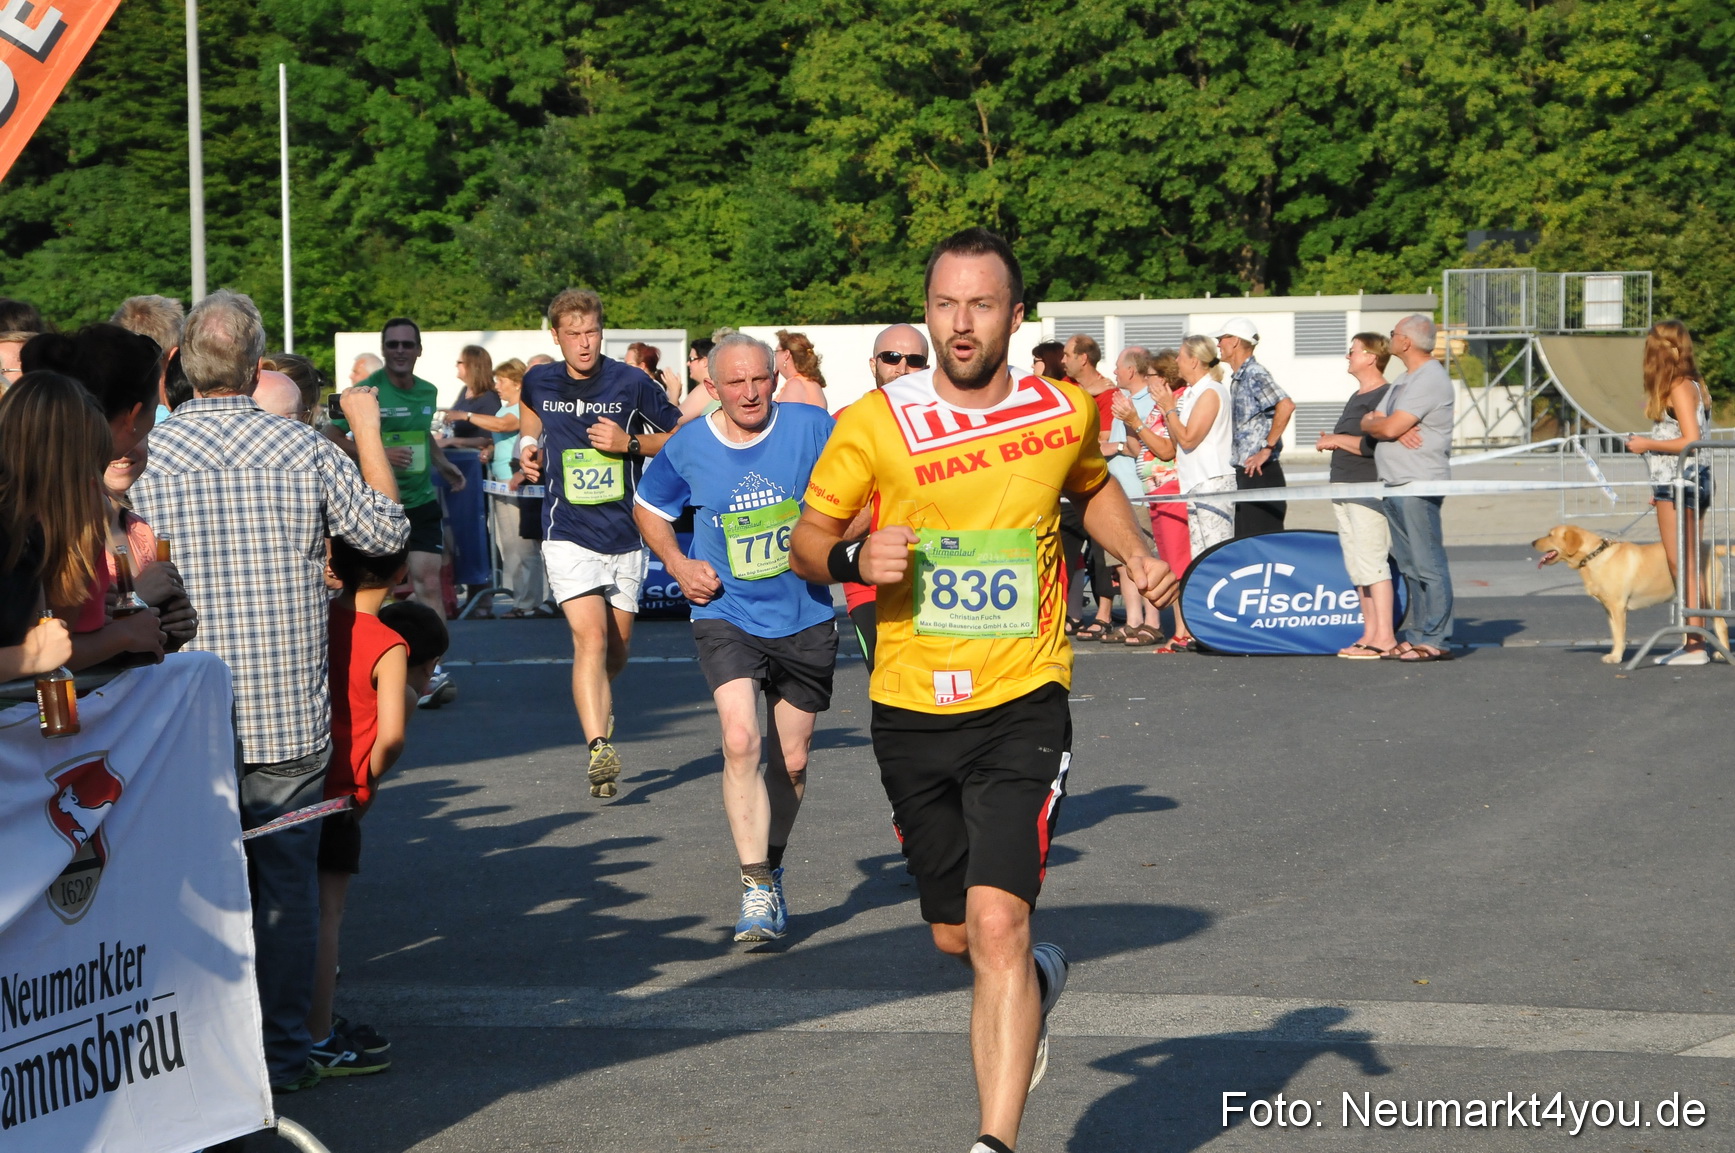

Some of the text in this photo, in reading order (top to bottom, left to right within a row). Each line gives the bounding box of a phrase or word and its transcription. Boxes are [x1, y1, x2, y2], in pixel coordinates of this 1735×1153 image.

[543, 400, 622, 414] EURO POLES
[914, 425, 1081, 487] MAX BÖGL
[572, 467, 615, 490] 324
[737, 526, 791, 563] 776
[932, 547, 977, 557] firmenlauf
[931, 568, 1018, 612] 836
[1239, 585, 1360, 616] Fische
[933, 621, 947, 629] Bögl
[948, 622, 982, 630] Bauservice
[982, 622, 1002, 630] GmbH
[949, 612, 1001, 621] Christian Fuchs
[1251, 614, 1364, 628] AUTOMOBILE
[61, 876, 93, 907] 1628
[0, 940, 146, 1033] Neumarkter
[0, 998, 186, 1130] ammsbräu
